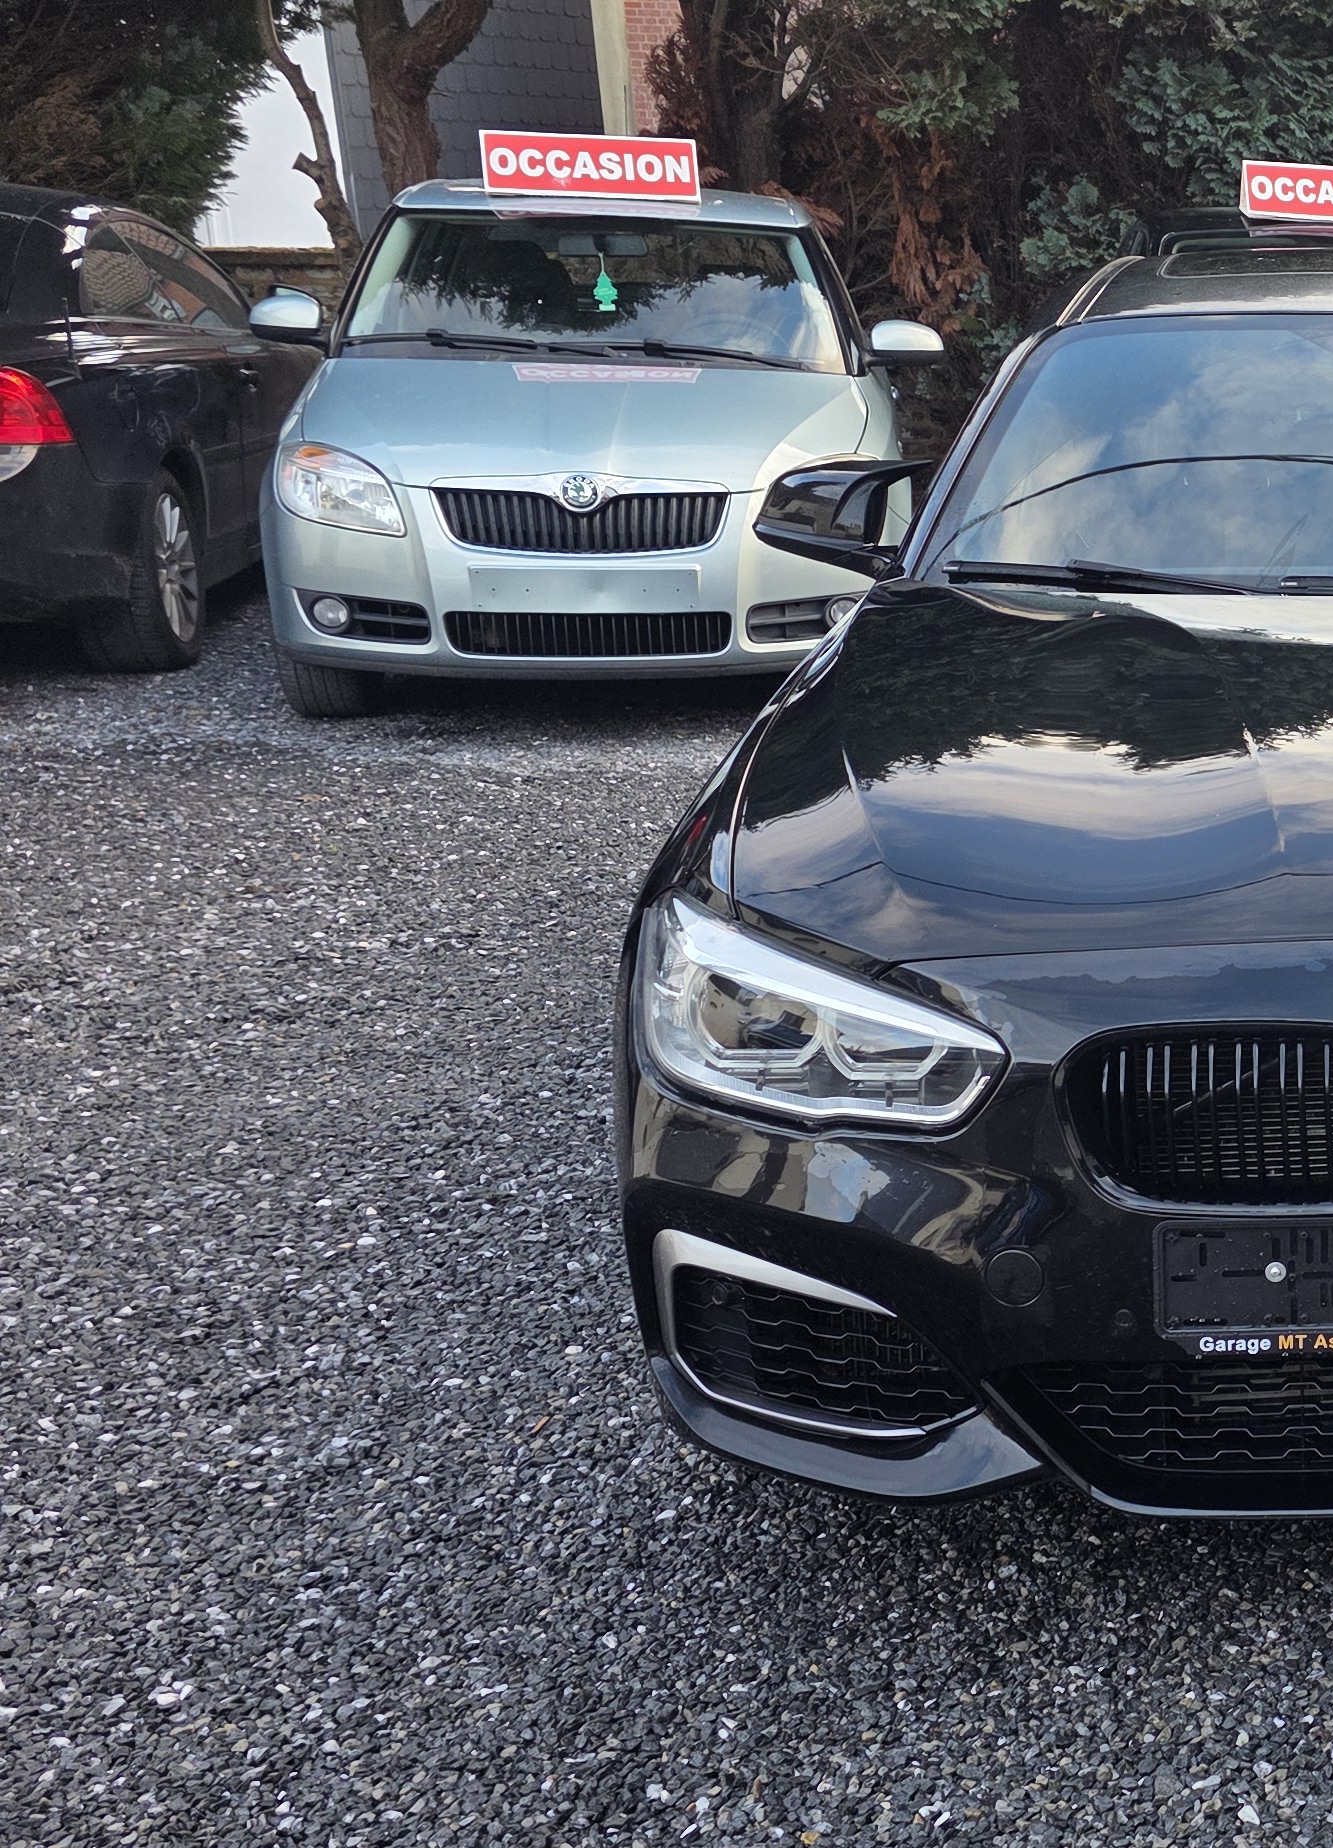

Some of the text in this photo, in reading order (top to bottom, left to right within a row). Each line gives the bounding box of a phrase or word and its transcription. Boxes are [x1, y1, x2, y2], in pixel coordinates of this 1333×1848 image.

[489, 147, 691, 183] OCCASION
[1200, 1336, 1271, 1354] Garage
[1278, 1334, 1307, 1349] MT
